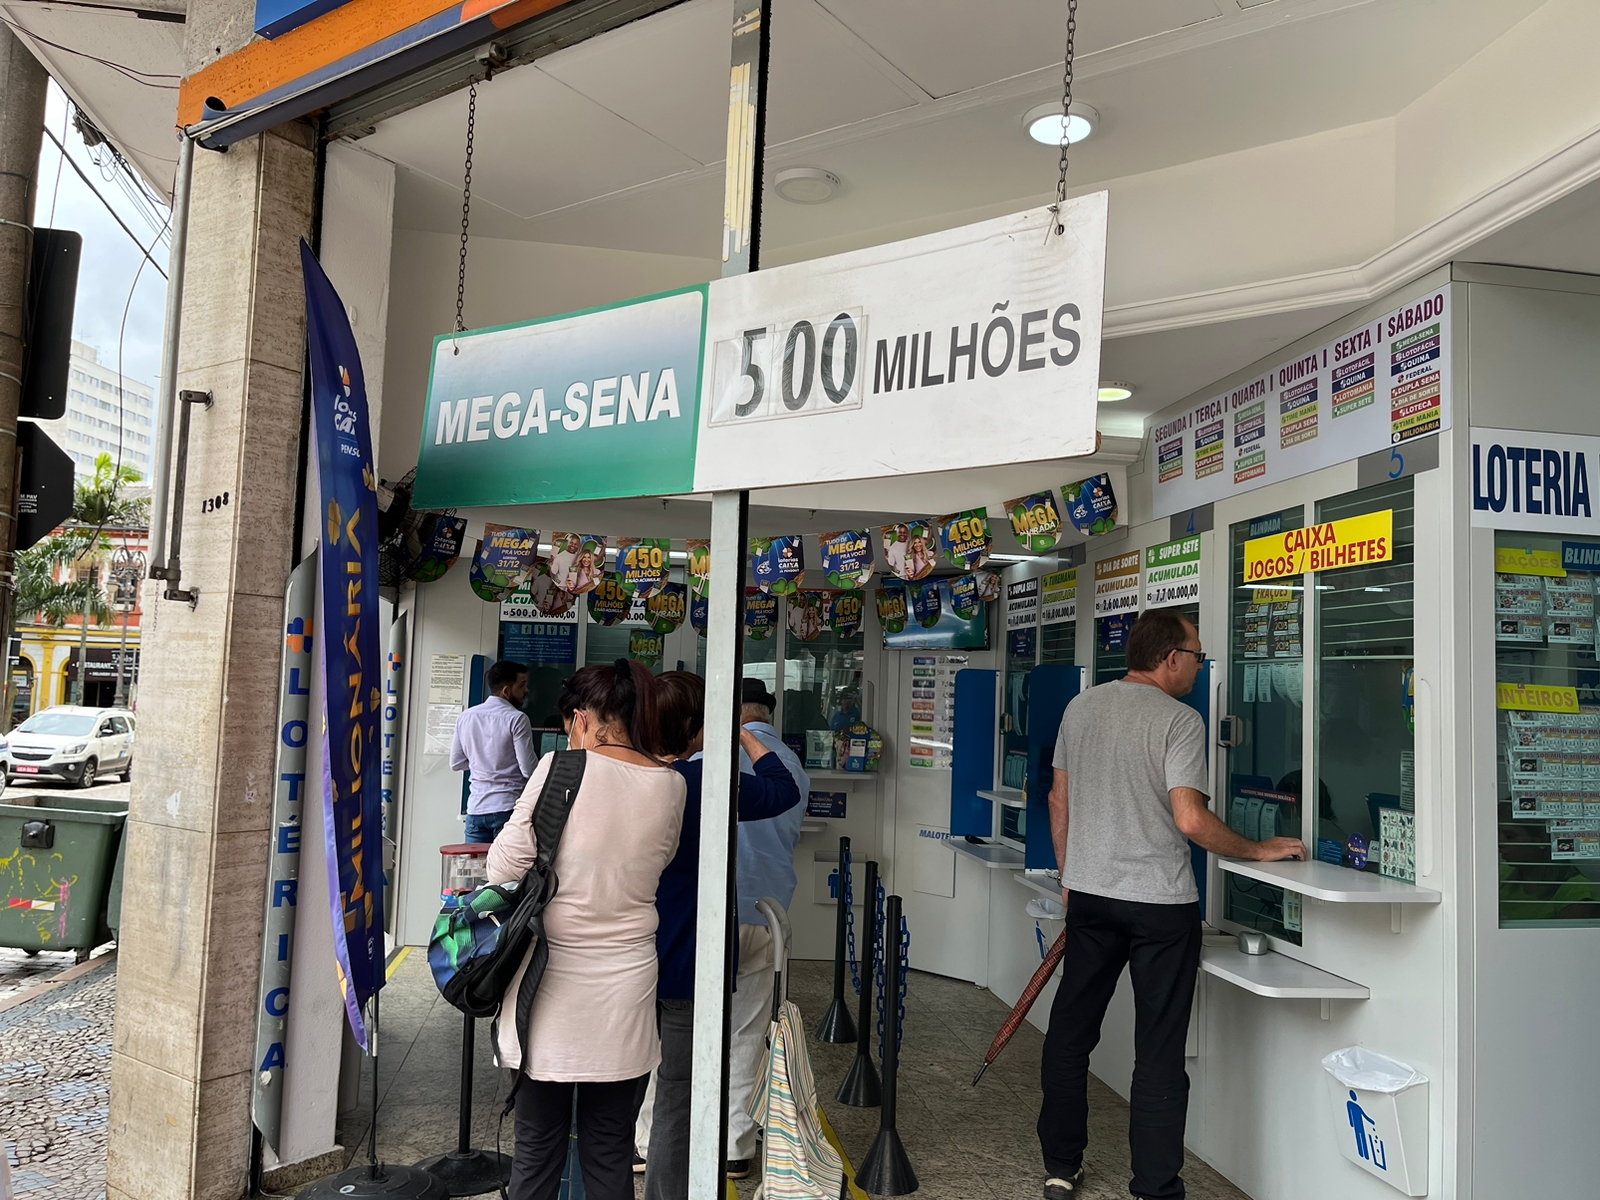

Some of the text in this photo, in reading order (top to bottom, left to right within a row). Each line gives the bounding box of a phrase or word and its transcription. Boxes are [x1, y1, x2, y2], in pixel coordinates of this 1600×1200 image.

[1401, 328, 1434, 347] MEGA-SENA
[734, 299, 1081, 418] 500 MILHÕES
[1402, 340, 1435, 359] LOTOFÁCIL
[1155, 293, 1444, 443] SEGUNDA TERÇA QUARTA QUINTA SEXTA SÁBADO
[1341, 358, 1371, 375] LOTOFÁCIL
[1407, 353, 1430, 368] QUINA
[1346, 372, 1366, 386] QUINA
[1405, 365, 1432, 380] FEDERAL
[1339, 382, 1373, 401] LOTOMANIA
[1398, 374, 1440, 394] DUPLA SENA
[1292, 395, 1310, 407] QUINA
[1398, 386, 1439, 404] DIA DE SORTE
[434, 367, 681, 445] MEGA-SENA
[1340, 396, 1372, 414] SUPER SETE
[1405, 400, 1432, 415] LOTECA
[1285, 417, 1318, 434] DUPLA SENA
[1399, 410, 1439, 428] TIME MANIA
[1243, 443, 1261, 454] FEDERAL
[1388, 447, 1404, 479] 5
[1473, 443, 1591, 518] LOTERIA
[201, 491, 229, 514] 1308
[1093, 499, 1112, 510] CAIXA
[1012, 506, 1059, 534] MEGA
[1186, 510, 1196, 534] 4
[949, 517, 983, 543] 450
[1284, 523, 1336, 553] CAIXA
[491, 537, 530, 549] MEGA
[828, 541, 864, 555] MEGA
[953, 538, 985, 554] MILHÕES
[1159, 538, 1199, 560] SUPER SETE
[497, 560, 520, 568] 31/12
[624, 547, 663, 569] 450
[840, 562, 860, 572] 31/12
[1103, 554, 1139, 573] DIA DE SORTE
[1248, 554, 1294, 580] JOGOS
[1310, 537, 1386, 569] BILHETES
[625, 569, 661, 579] MILHÕES
[1148, 563, 1198, 584] ACUMULADA
[595, 581, 627, 601] 450
[1096, 576, 1138, 595] ACUMULADA
[648, 594, 685, 612] MEGA
[747, 600, 773, 610] MEGA
[835, 597, 859, 616] 450
[878, 599, 906, 616] MEGA
[631, 639, 662, 652] MEGA
[1499, 688, 1575, 708] INTEIROS
[259, 667, 310, 1073] LOTÉRICA
